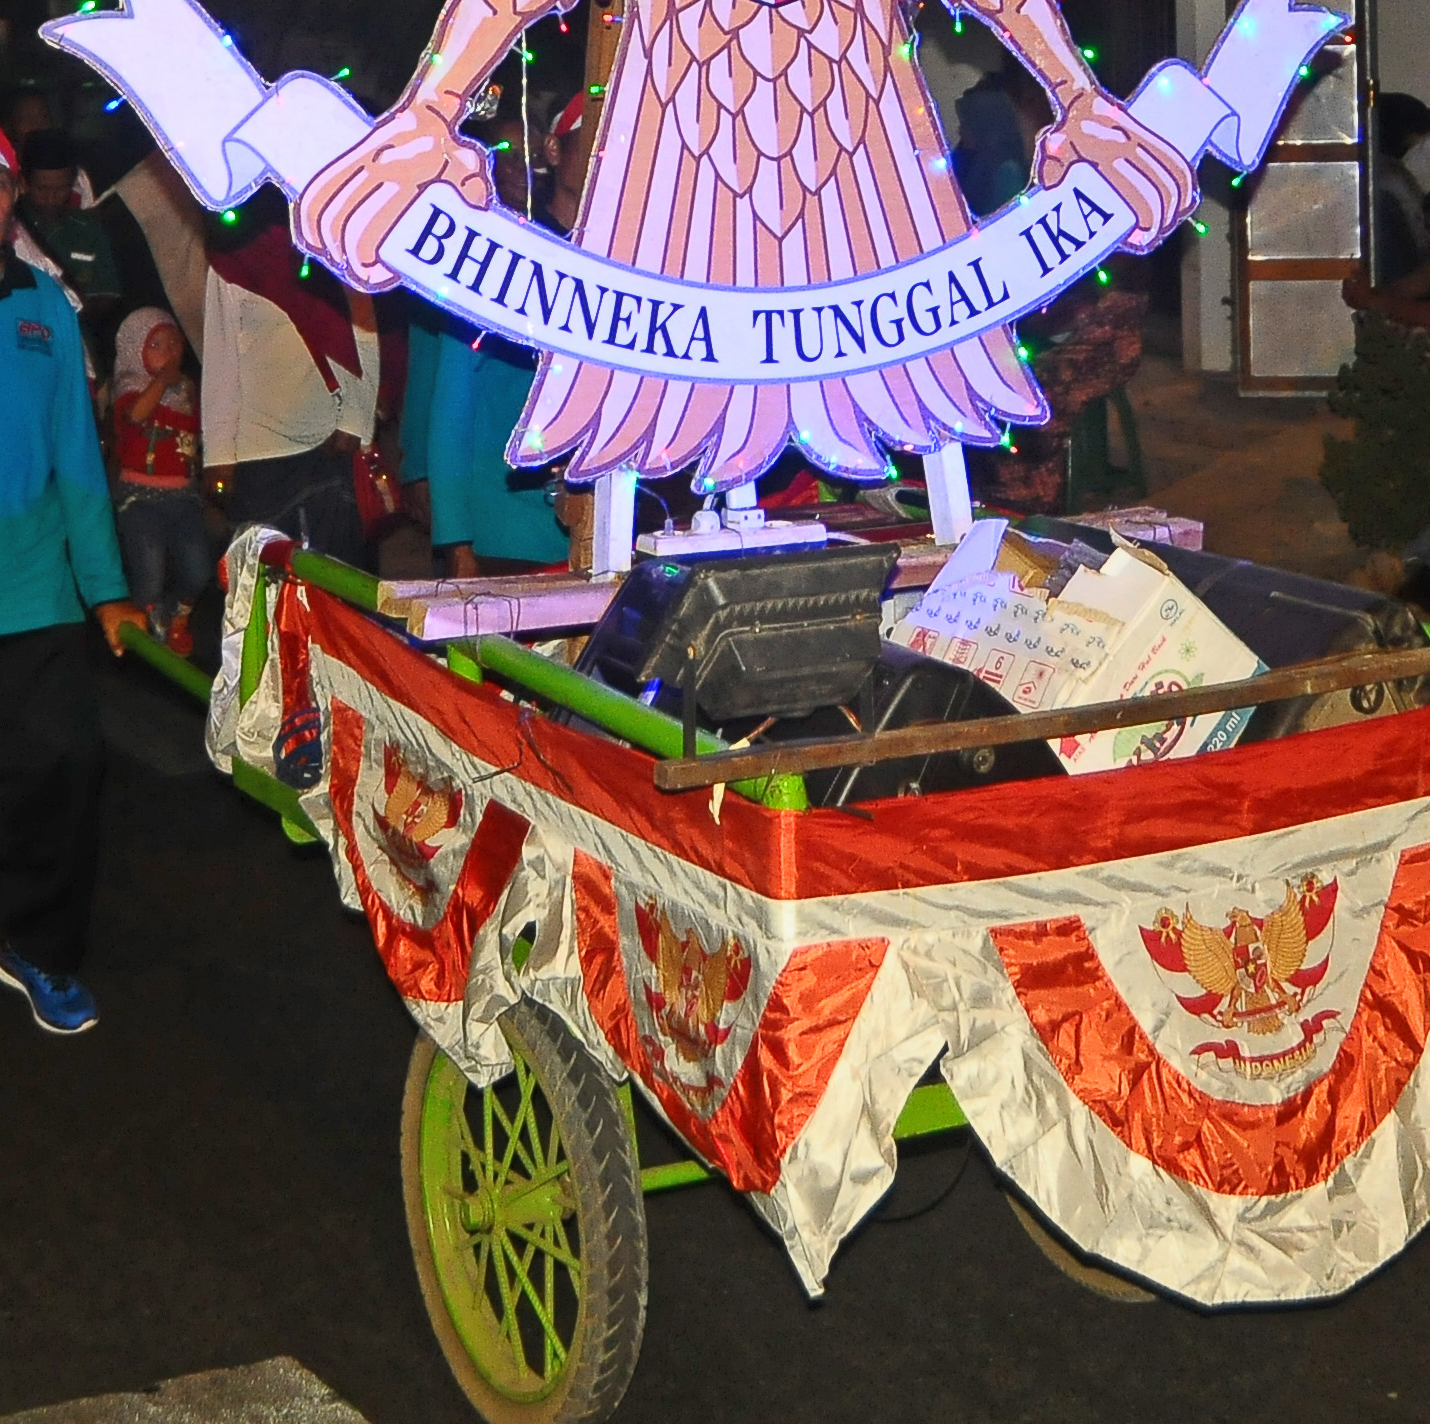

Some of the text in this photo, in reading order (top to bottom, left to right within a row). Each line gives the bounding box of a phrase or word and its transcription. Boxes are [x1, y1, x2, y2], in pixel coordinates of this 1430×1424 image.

[405, 185, 1115, 364] BHINNEKA TUNGGAL IKA
[1225, 711, 1241, 733] ml
